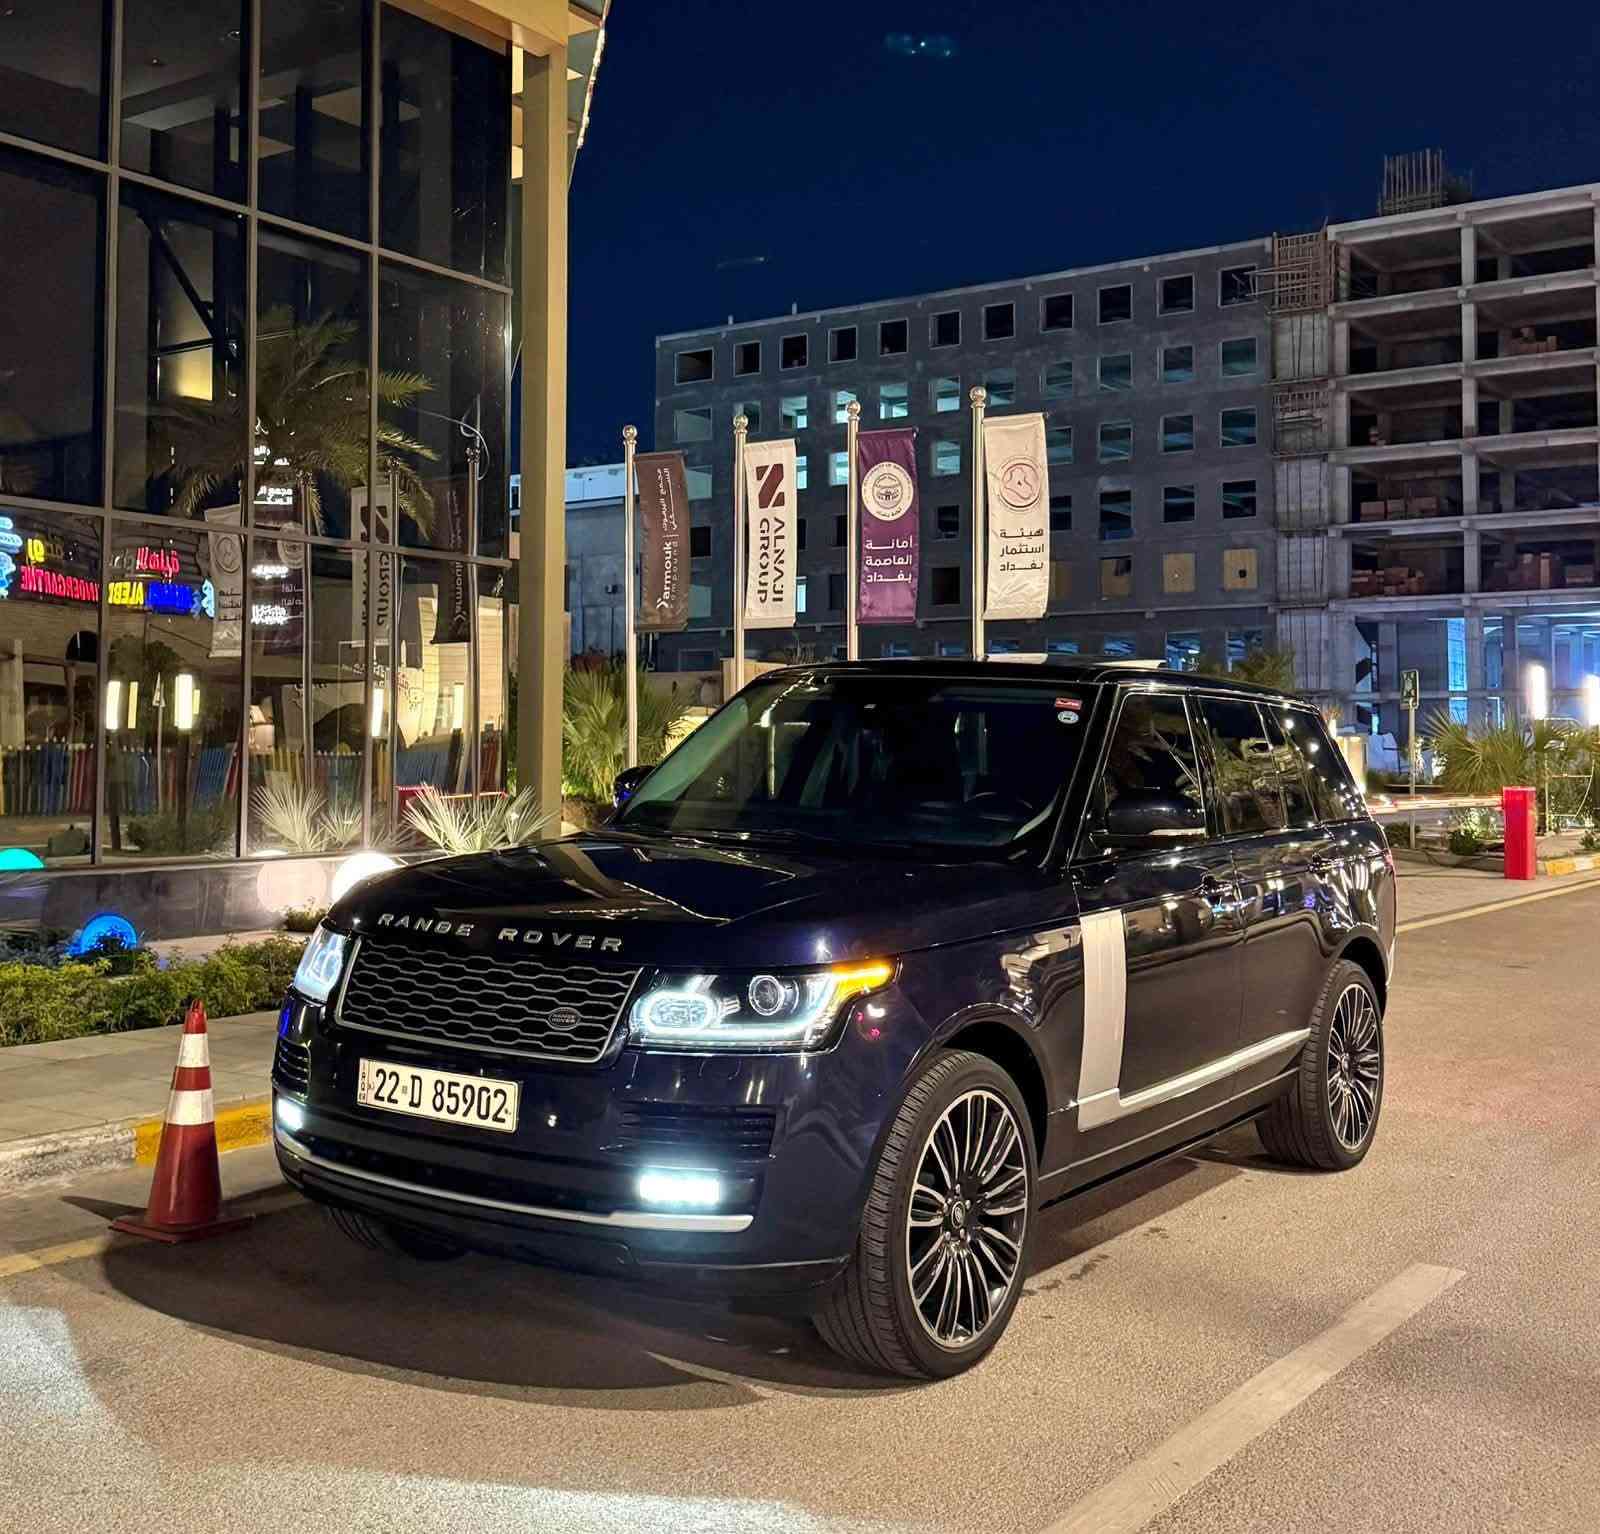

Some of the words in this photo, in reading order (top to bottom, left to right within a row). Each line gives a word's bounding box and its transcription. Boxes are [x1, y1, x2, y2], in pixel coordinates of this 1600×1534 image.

[1000, 527, 1044, 539] هيئة
[757, 518, 770, 604] GROUP
[772, 517, 785, 603] ALNAJI
[865, 554, 912, 567] العاصمة
[1000, 543, 1044, 557] استثمار
[655, 541, 673, 609] Yarmouk
[866, 570, 912, 584] بغداد
[1000, 560, 1044, 572] بغداد
[377, 913, 475, 937] RANGE
[498, 928, 624, 952] ROVER
[374, 1068, 400, 1105] 22
[409, 1074, 423, 1108] D
[432, 1079, 508, 1124] 85902
